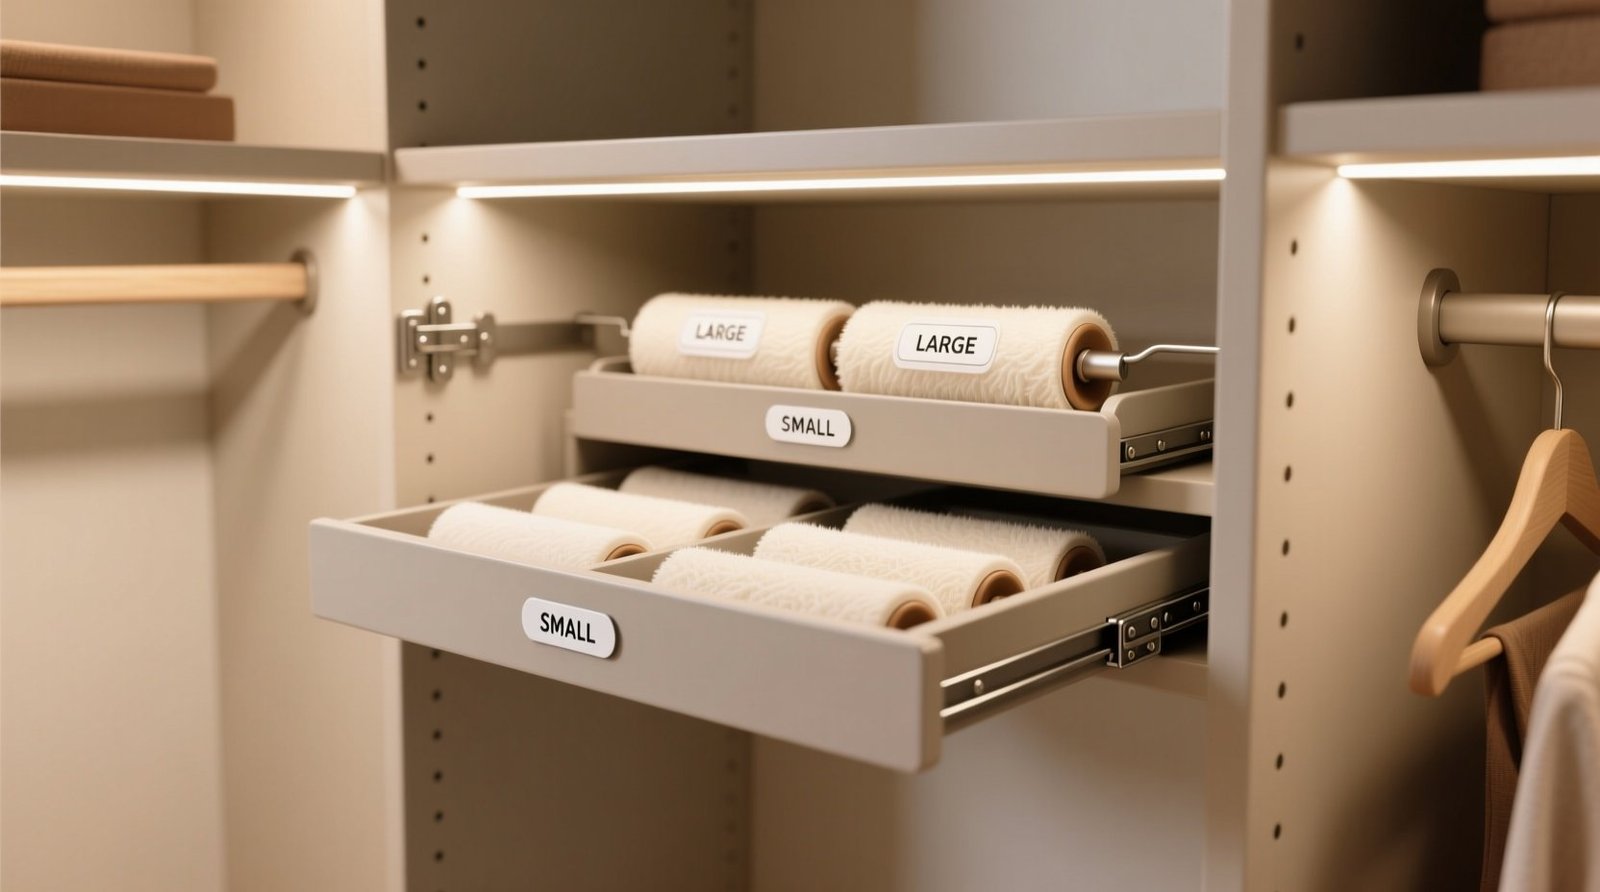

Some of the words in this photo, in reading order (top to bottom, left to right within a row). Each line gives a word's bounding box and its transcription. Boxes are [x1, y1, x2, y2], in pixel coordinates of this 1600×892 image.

[694, 323, 747, 342] LARGE
[915, 334, 978, 355] LARGE
[781, 415, 836, 438] SMALL
[539, 611, 596, 644] SMALL
